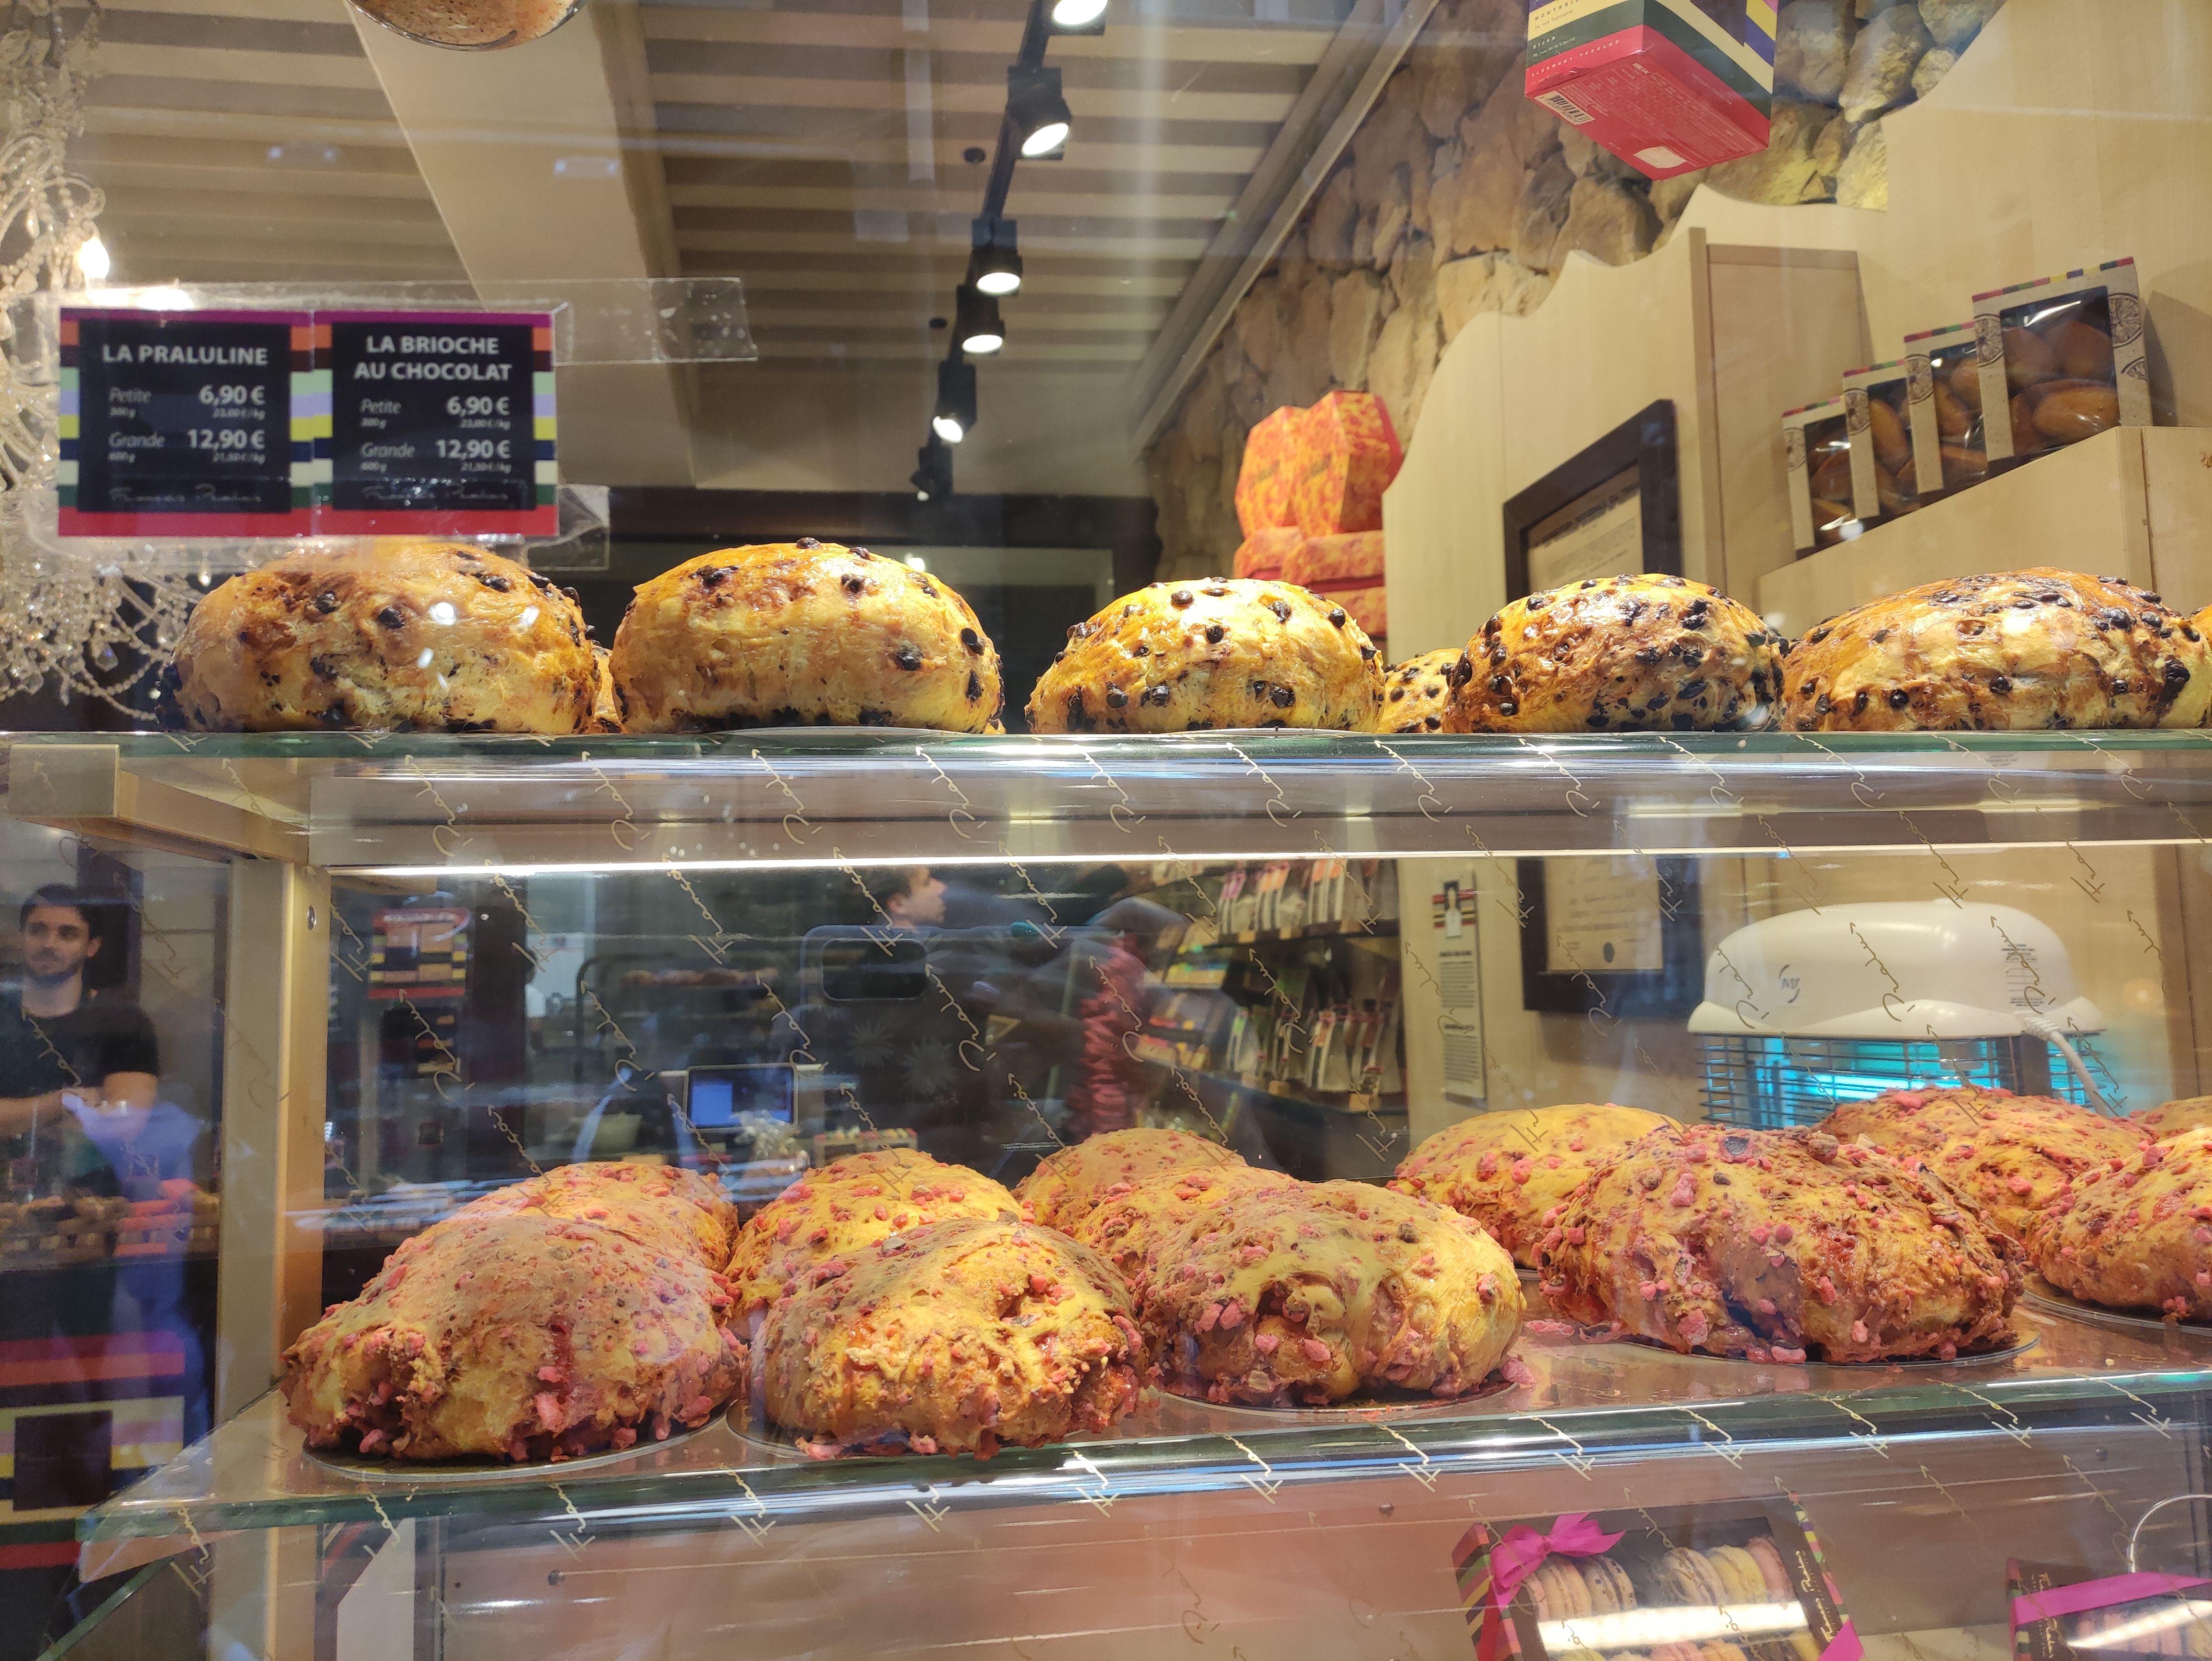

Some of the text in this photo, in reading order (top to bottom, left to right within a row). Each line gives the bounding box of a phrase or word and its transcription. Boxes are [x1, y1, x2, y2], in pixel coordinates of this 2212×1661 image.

[1533, 35, 1556, 49] DIJON
[102, 343, 269, 366] LA PRALULINE
[365, 335, 500, 355] LA BRIOCHE
[353, 361, 513, 381] AU CHOCOLAT
[108, 385, 265, 408] Petite 6,90 €
[359, 395, 510, 418] Petite 6,90 €
[108, 429, 265, 451] Grande 12,90 €
[360, 439, 511, 461] Grande 12,90 €
